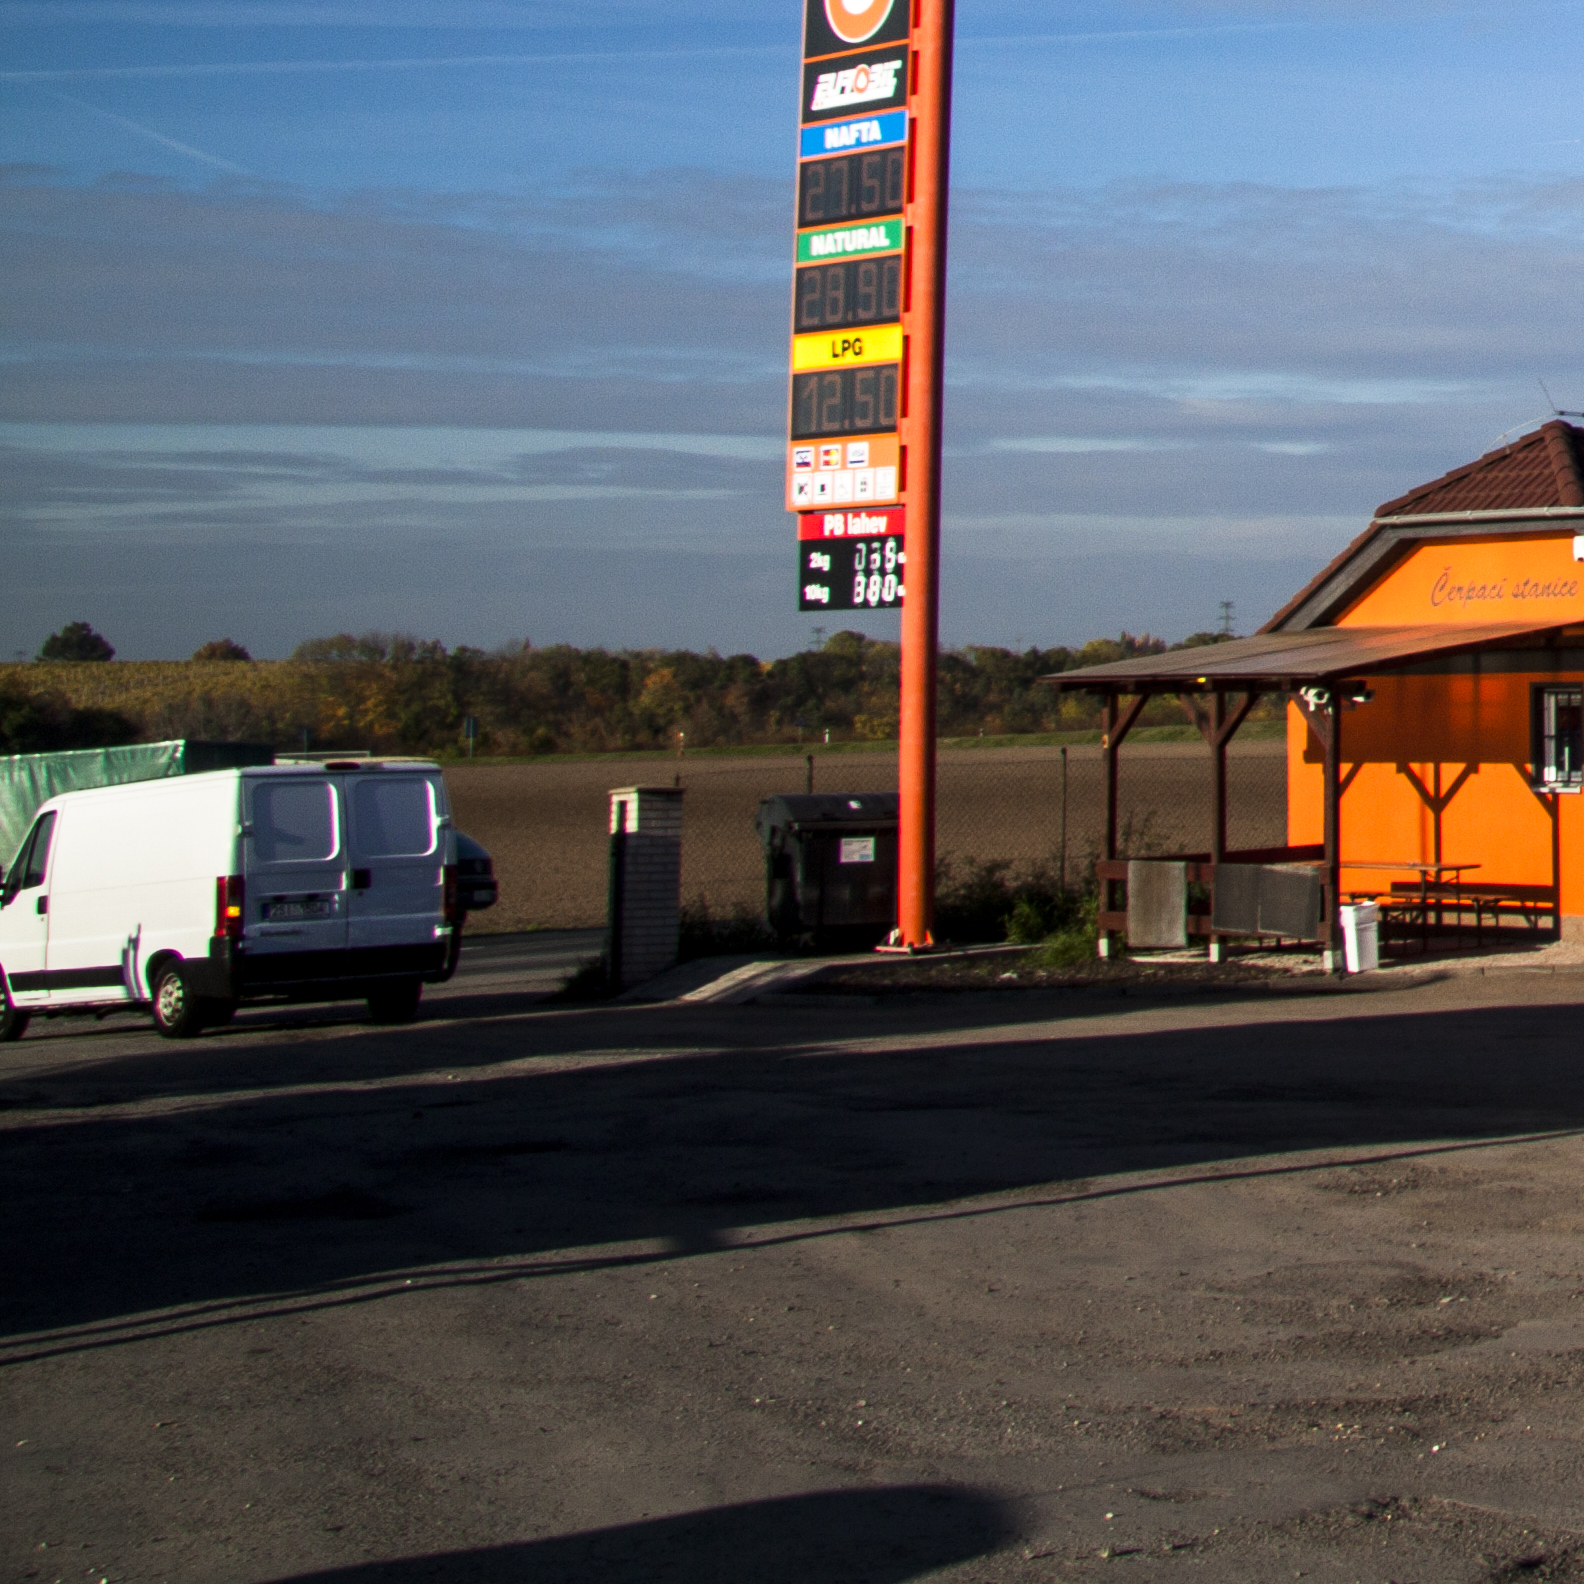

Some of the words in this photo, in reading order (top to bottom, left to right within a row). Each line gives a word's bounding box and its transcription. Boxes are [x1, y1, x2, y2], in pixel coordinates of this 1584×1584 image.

[824, 120, 882, 149] NAFTA
[805, 151, 903, 220] 27.50
[810, 225, 889, 256] NATURAL
[801, 259, 899, 325] 28.90
[831, 337, 863, 359] LPG
[802, 368, 897, 432] 12.50
[824, 514, 845, 536] PB
[847, 512, 887, 535] lahev
[809, 552, 831, 571] 2kg
[1431, 566, 1507, 609] Čerpací
[1512, 577, 1578, 599] stanice
